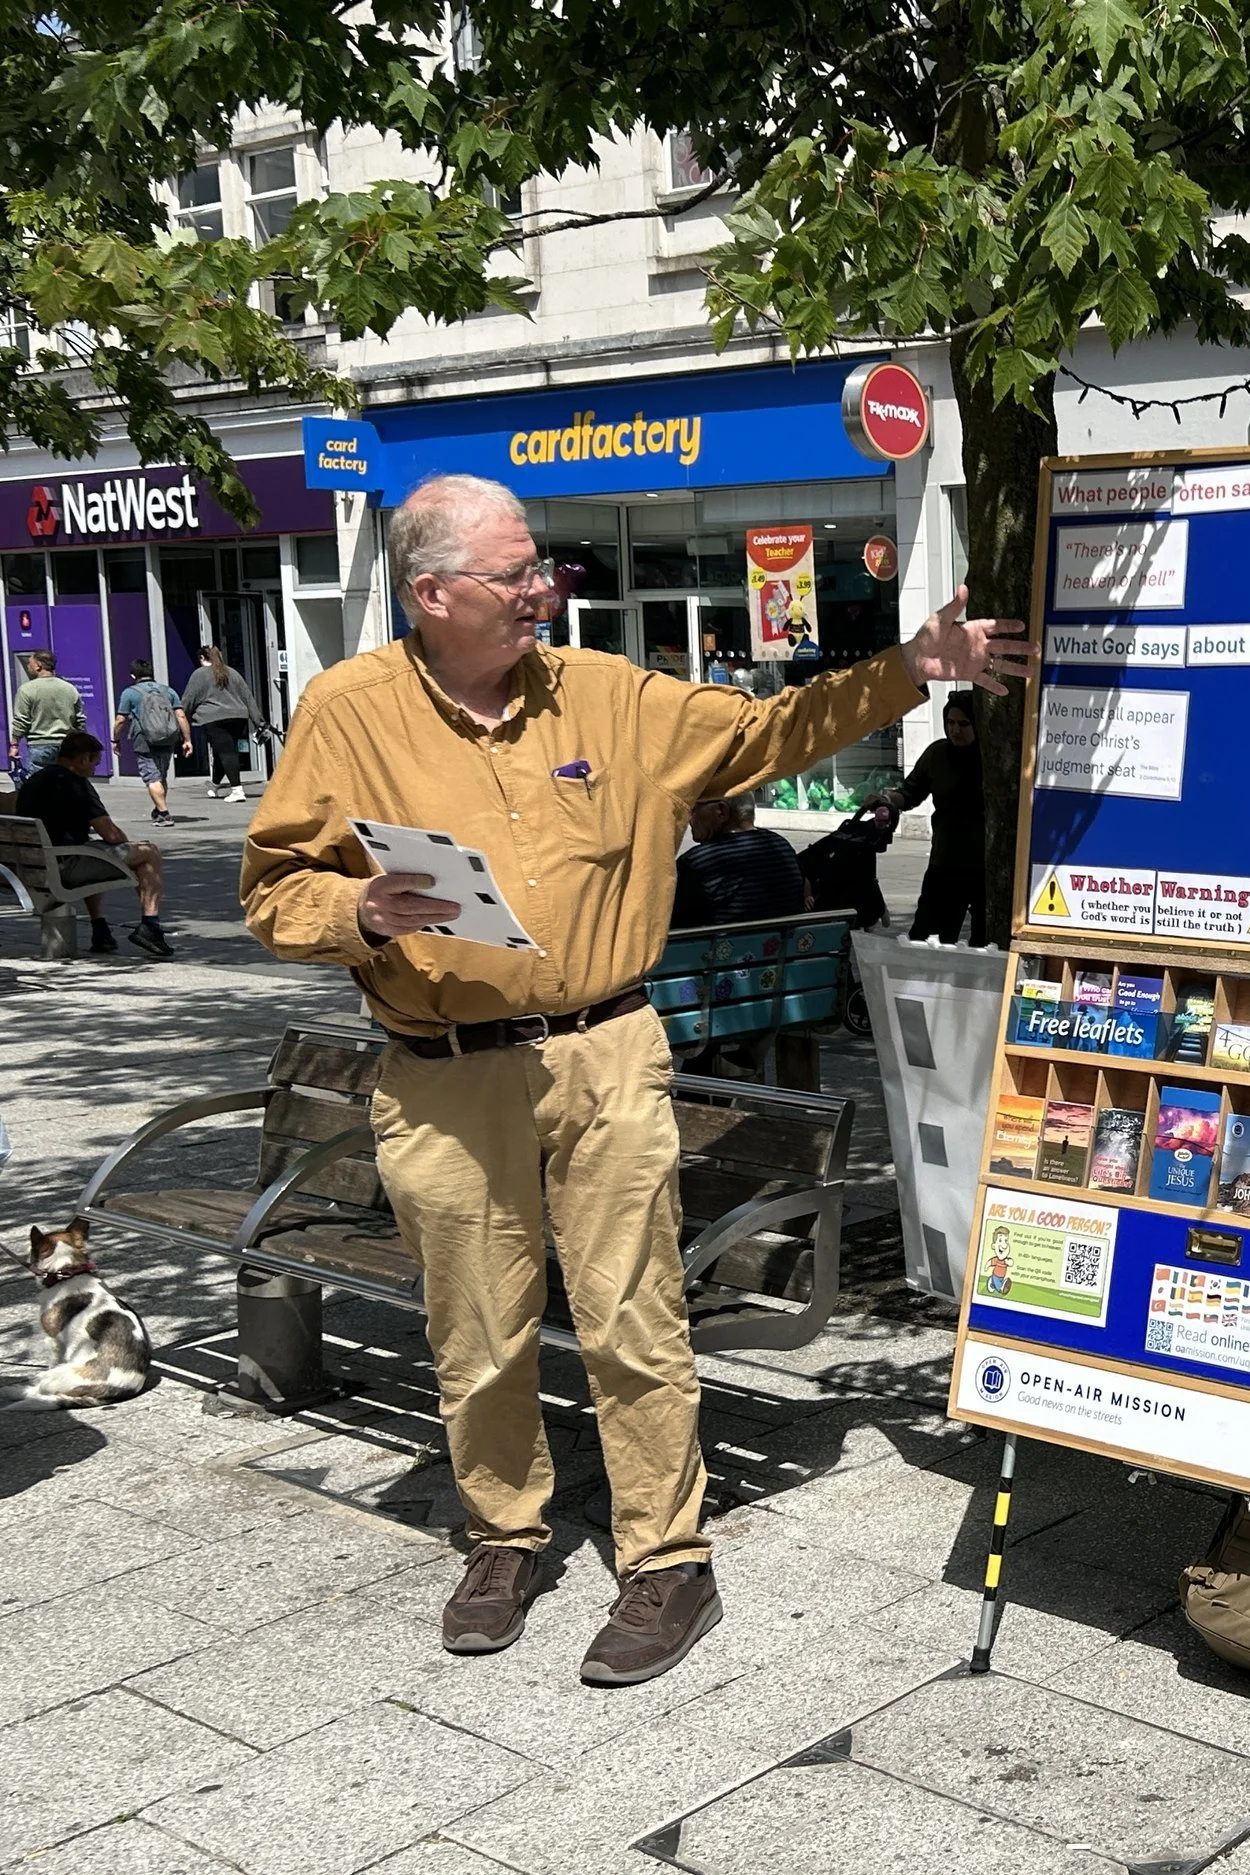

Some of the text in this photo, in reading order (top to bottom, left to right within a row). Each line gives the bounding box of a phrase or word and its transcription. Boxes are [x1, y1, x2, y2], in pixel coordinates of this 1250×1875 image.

[326, 438, 357, 453] card
[510, 410, 701, 465] cardfactory
[318, 456, 368, 475] factory
[61, 474, 199, 534] NatWest
[1058, 487, 1102, 503] What
[1106, 482, 1166, 505] people
[1179, 484, 1226, 502] often
[753, 534, 806, 546] Celebrate your
[1128, 543, 1147, 556] no
[766, 547, 794, 557] Teacher
[1063, 574, 1116, 589] heaven
[1120, 575, 1133, 587] or
[1053, 636, 1098, 655] What
[1102, 637, 1136, 655] God
[1141, 641, 1180, 657] says
[1193, 635, 1245, 653] about
[1048, 702, 1175, 726] We must all appear
[1046, 730, 1140, 750] before Christ's
[1041, 756, 1136, 778] judgment seat
[1070, 874, 1153, 896] Whether
[1088, 901, 1242, 921] whether you believe it or not
[1081, 911, 1235, 933] God's word is still the truth
[1118, 989, 1161, 1001] Good Enough
[1028, 1010, 1069, 1037] Free
[1072, 1014, 1144, 1045] leaflets
[1219, 1030, 1232, 1047] 4
[1165, 1174, 1194, 1187] JESUS
[1168, 1166, 1195, 1177] UNIQUE
[988, 1203, 1112, 1236] ARE YOU A GOOD PERSON?
[1177, 1324, 1207, 1344] Read
[1175, 1344, 1250, 1369] oamission.com/uq
[1020, 1371, 1186, 1422] OPEN-AIR MISSION
[1017, 1391, 1123, 1425] Good news on the streets
